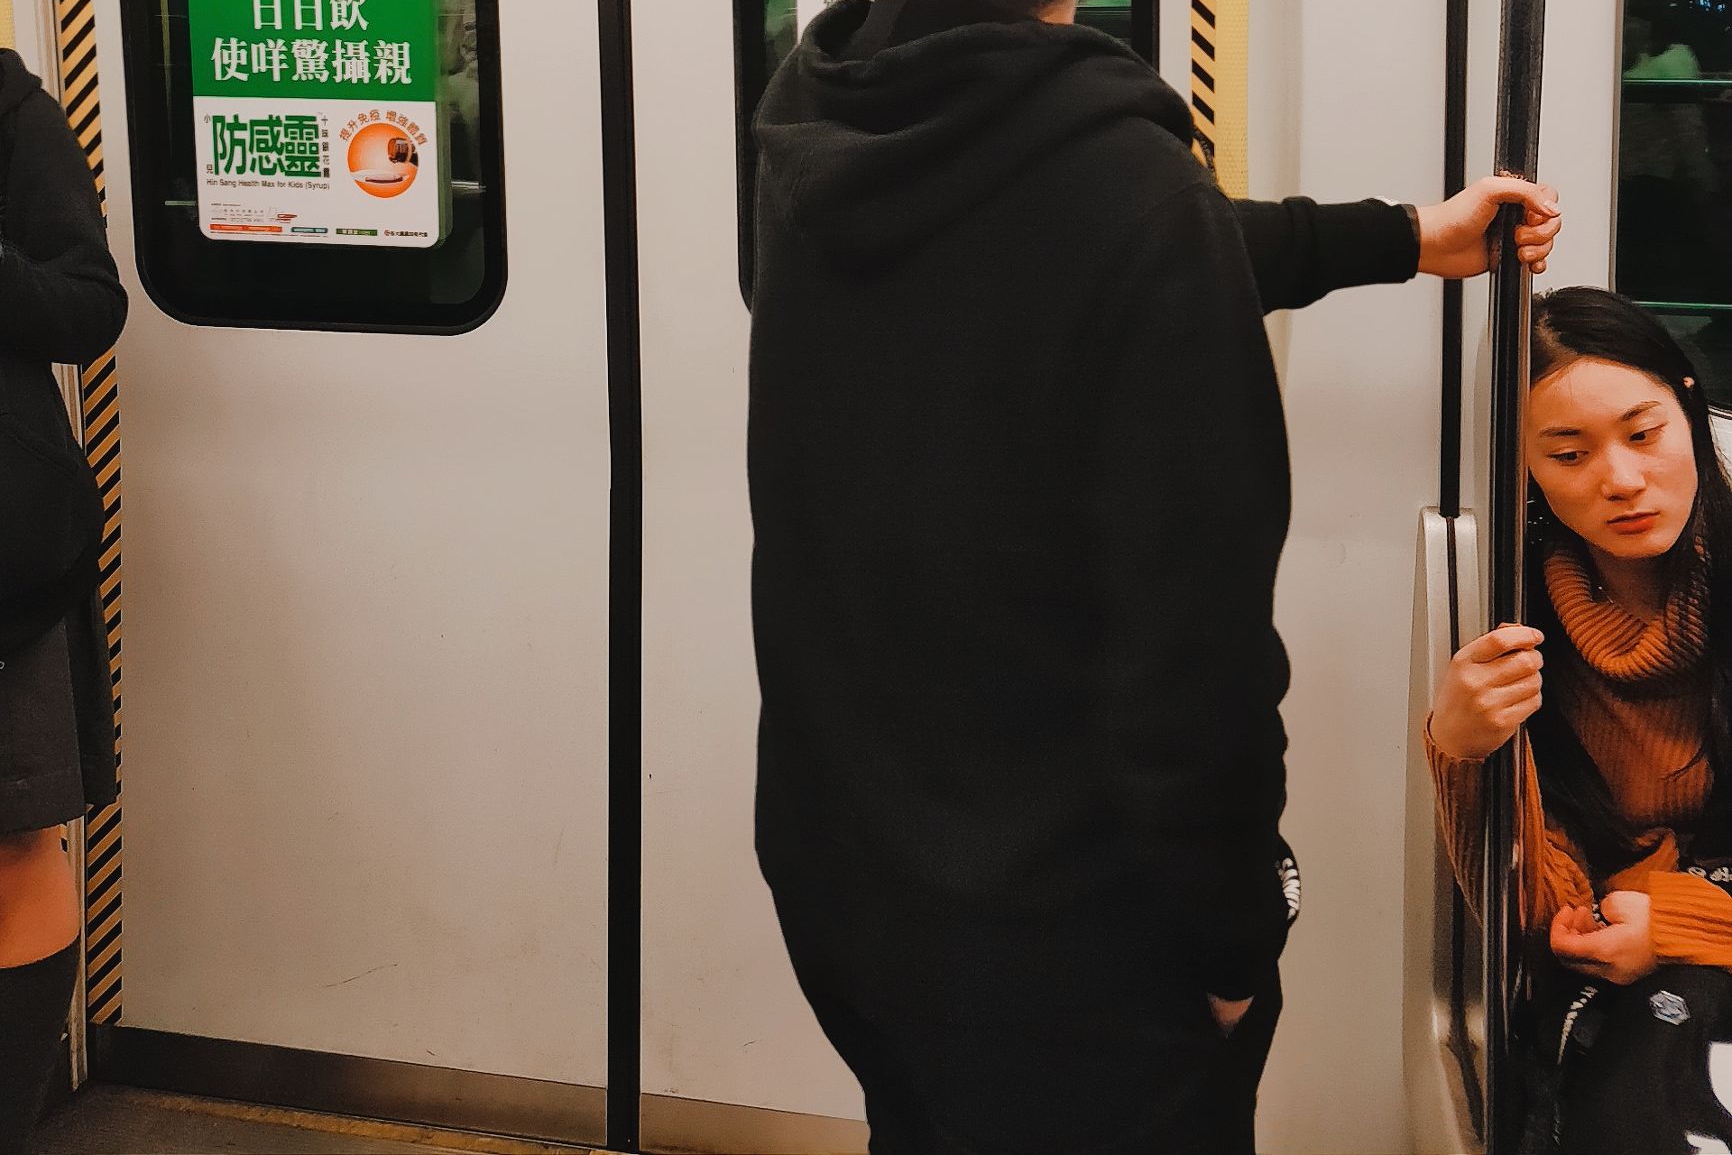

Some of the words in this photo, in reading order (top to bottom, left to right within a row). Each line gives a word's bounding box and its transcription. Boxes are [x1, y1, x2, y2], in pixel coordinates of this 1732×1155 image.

[211, 37, 413, 85] 使咩驚攝親
[212, 114, 321, 177] 防感靈
[220, 179, 236, 188] Sang
